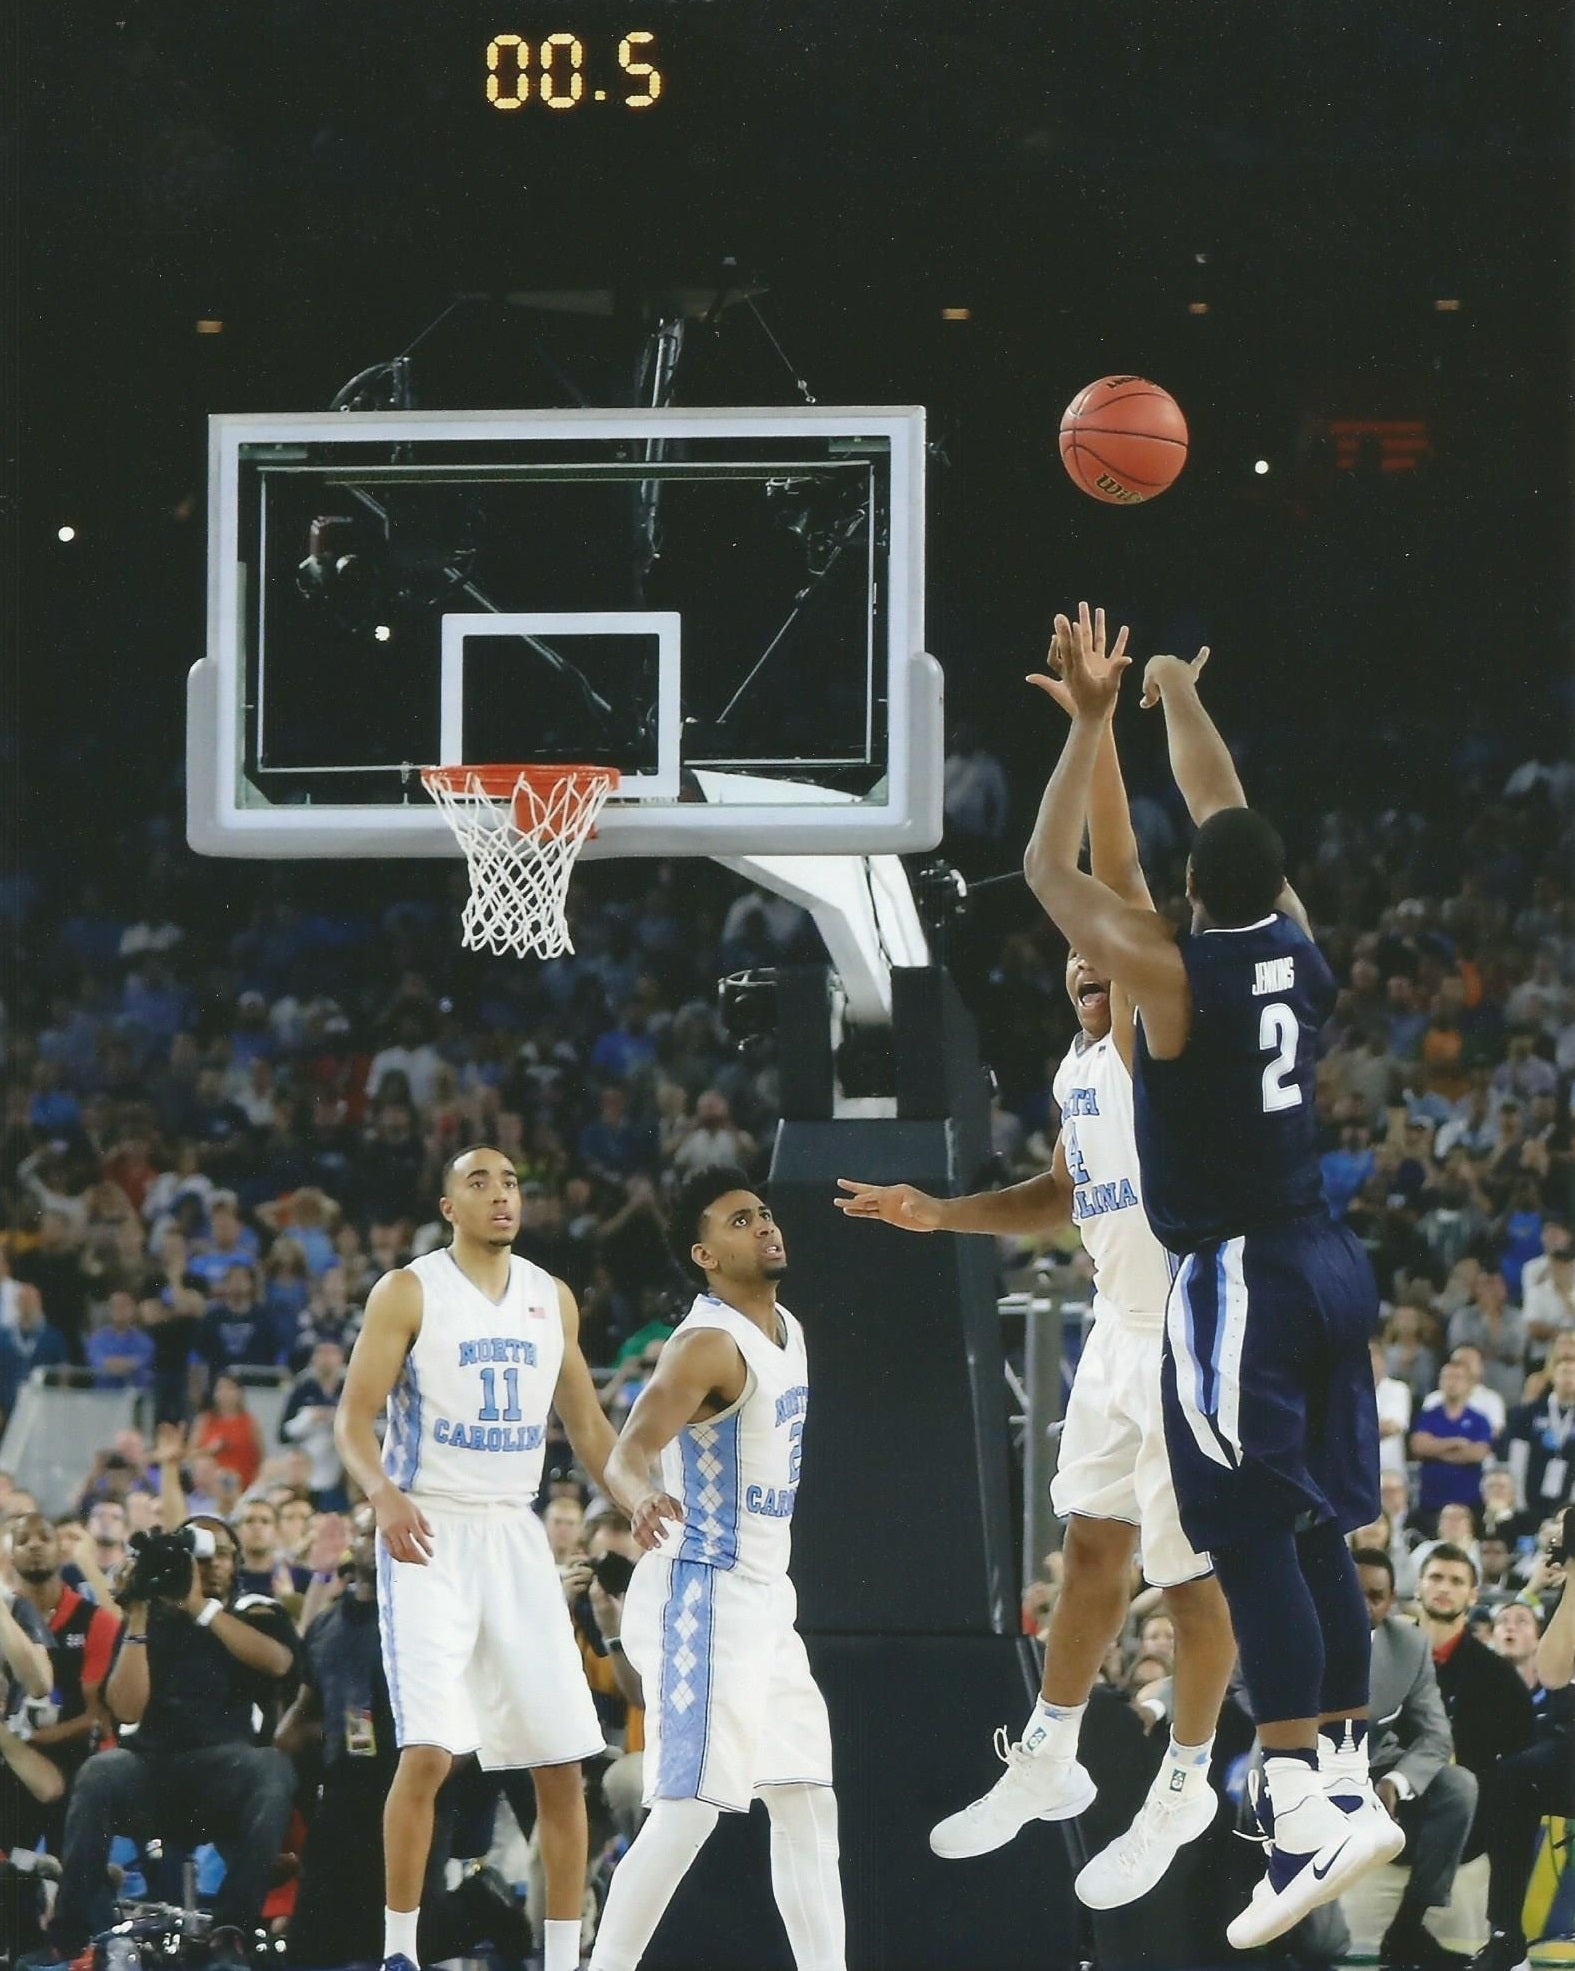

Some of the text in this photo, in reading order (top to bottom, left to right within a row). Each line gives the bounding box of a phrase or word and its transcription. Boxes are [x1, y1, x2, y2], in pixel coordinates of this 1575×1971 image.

[486, 31, 661, 109] 00.5
[1259, 1002, 1302, 1113] 2
[1072, 1178, 1138, 1220] LINA
[458, 1337, 537, 1368] NORTH
[479, 1367, 522, 1421] 11
[433, 1417, 546, 1452] CAROLIN
